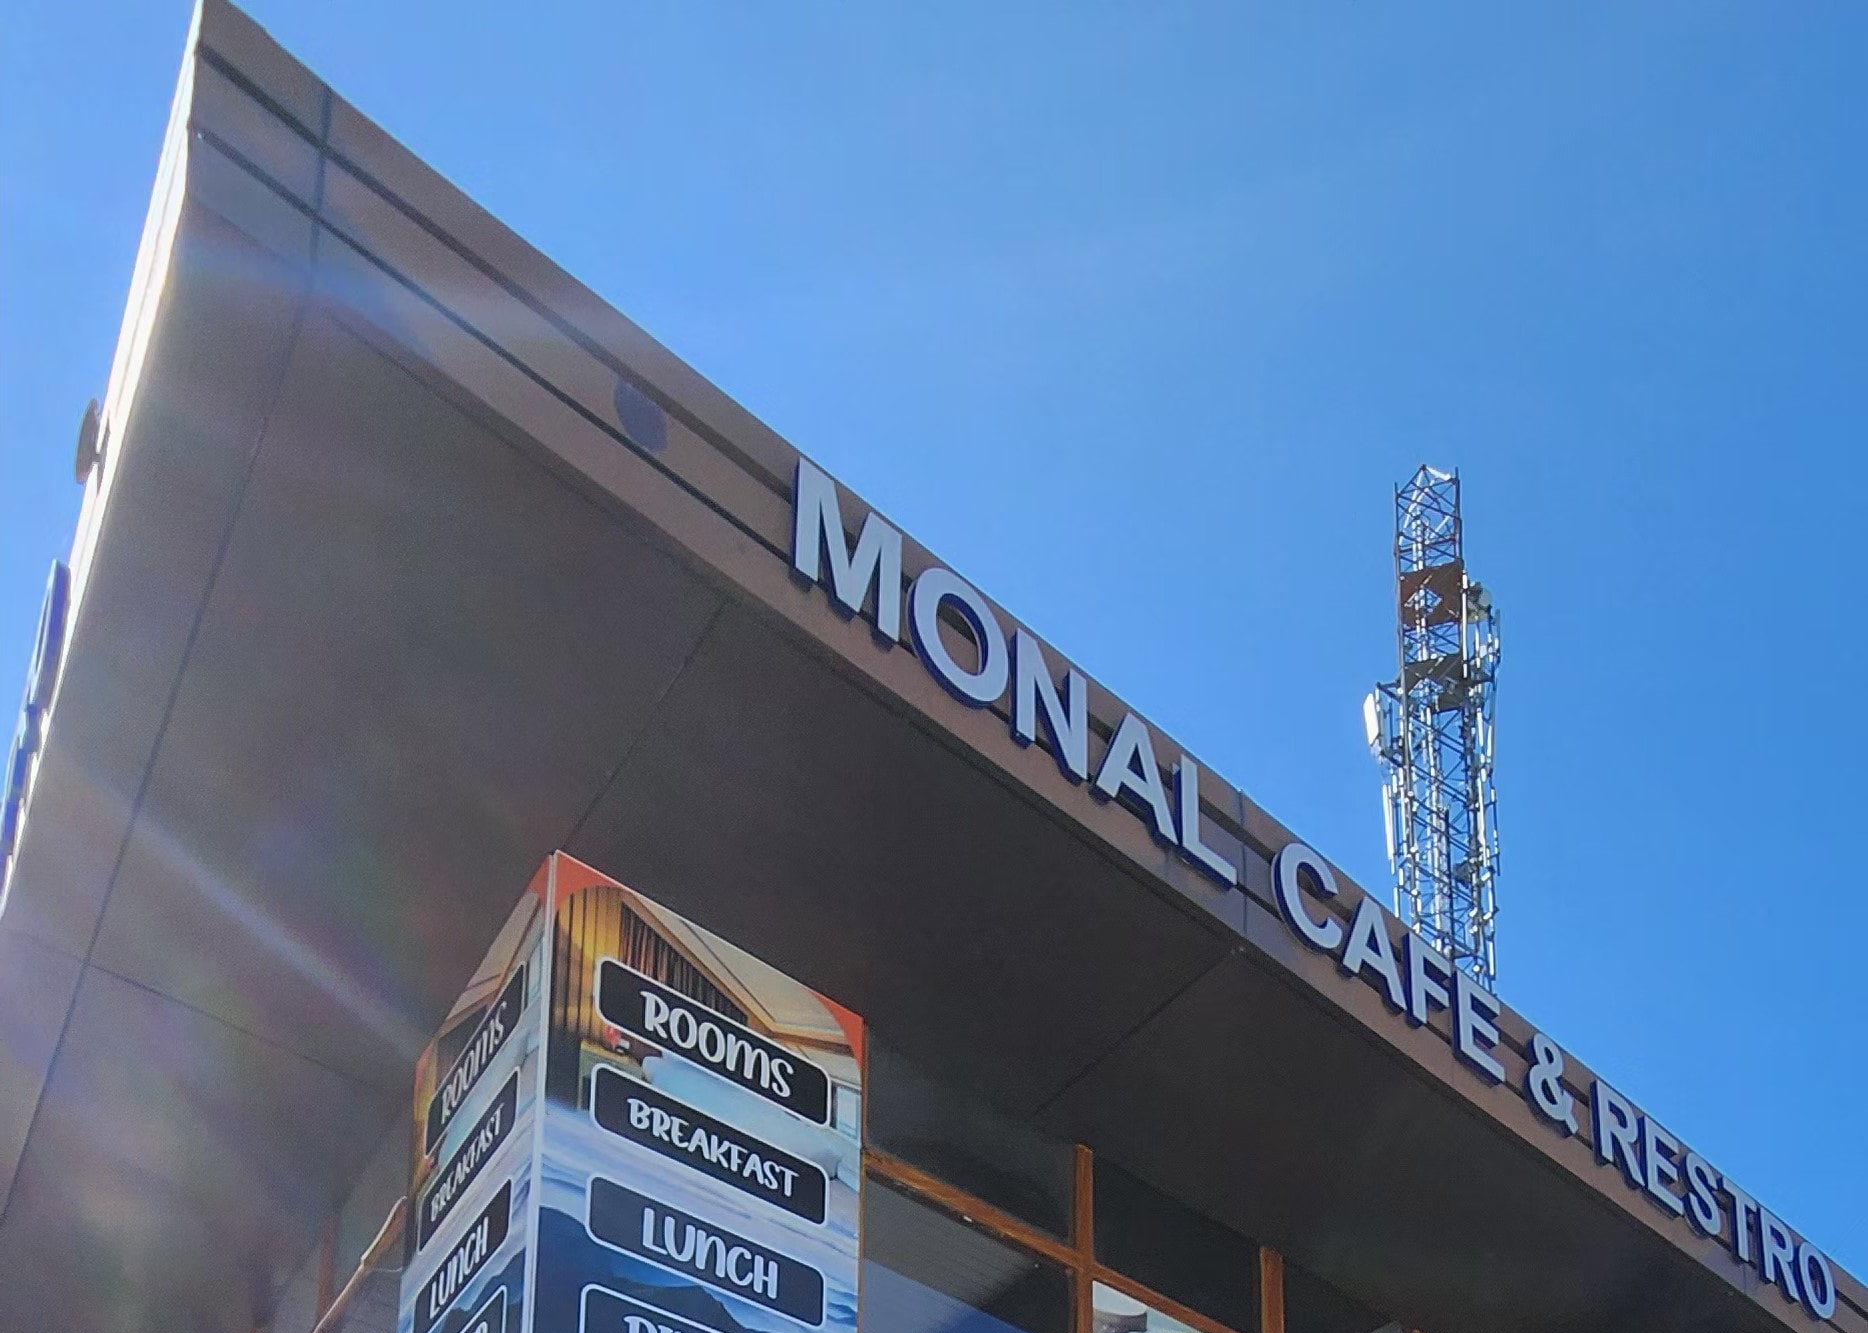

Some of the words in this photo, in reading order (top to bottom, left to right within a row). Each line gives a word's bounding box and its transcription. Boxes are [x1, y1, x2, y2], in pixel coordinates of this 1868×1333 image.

[793, 457, 1237, 887] MONAL
[1271, 842, 1505, 1085] CAFE
[1527, 1033, 1579, 1137] &
[1589, 1078, 1836, 1321] RESTRO
[441, 1001, 507, 1125] ROOMS
[641, 990, 795, 1098] ROOMS
[431, 1102, 505, 1223] BREAKFAST
[627, 1098, 799, 1198] BREAKFAST
[429, 1216, 489, 1319] LUNCH
[642, 1208, 779, 1299] LUNCH
